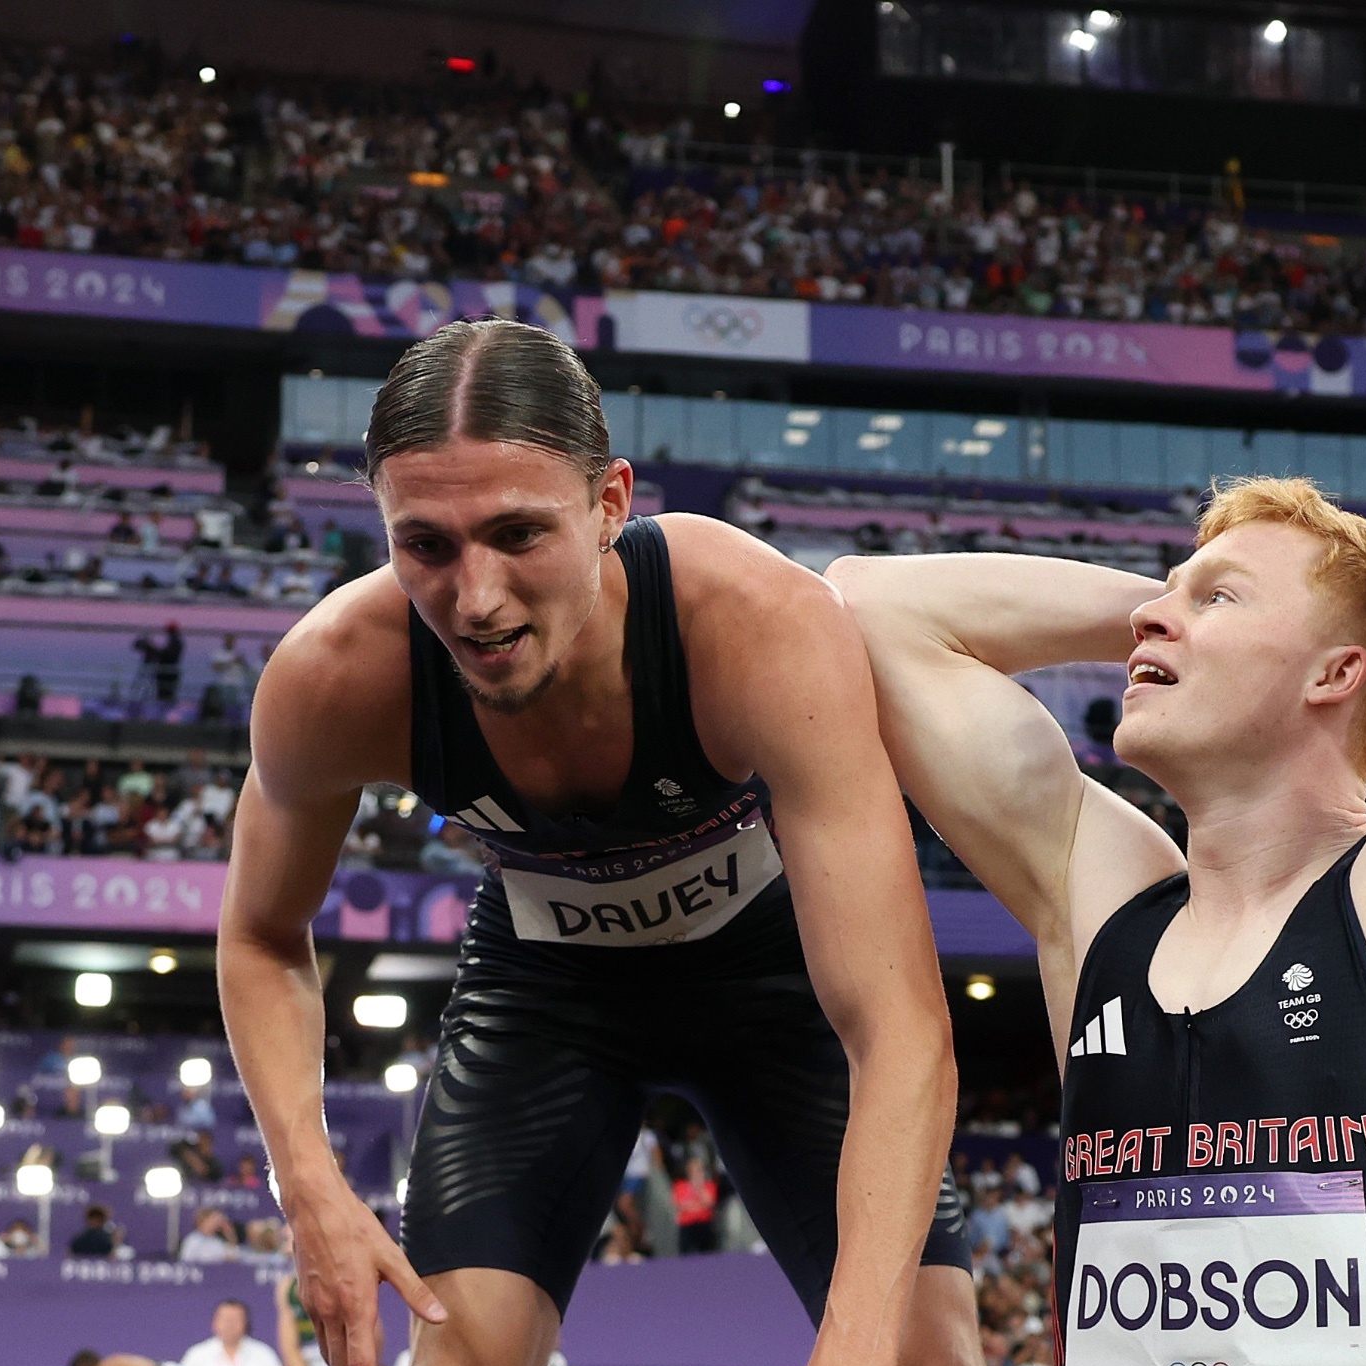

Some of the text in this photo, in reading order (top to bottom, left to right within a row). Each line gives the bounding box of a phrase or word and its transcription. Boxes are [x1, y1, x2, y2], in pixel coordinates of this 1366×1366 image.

[45, 267, 165, 306] 2024
[72, 873, 202, 912] 2024
[548, 852, 739, 937] DAVEY
[1277, 993, 1322, 1010] TEAM GB
[1065, 1126, 1171, 1182] GREAT
[1203, 1184, 1276, 1205] 2024
[1077, 1257, 1361, 1331] DOBSON
